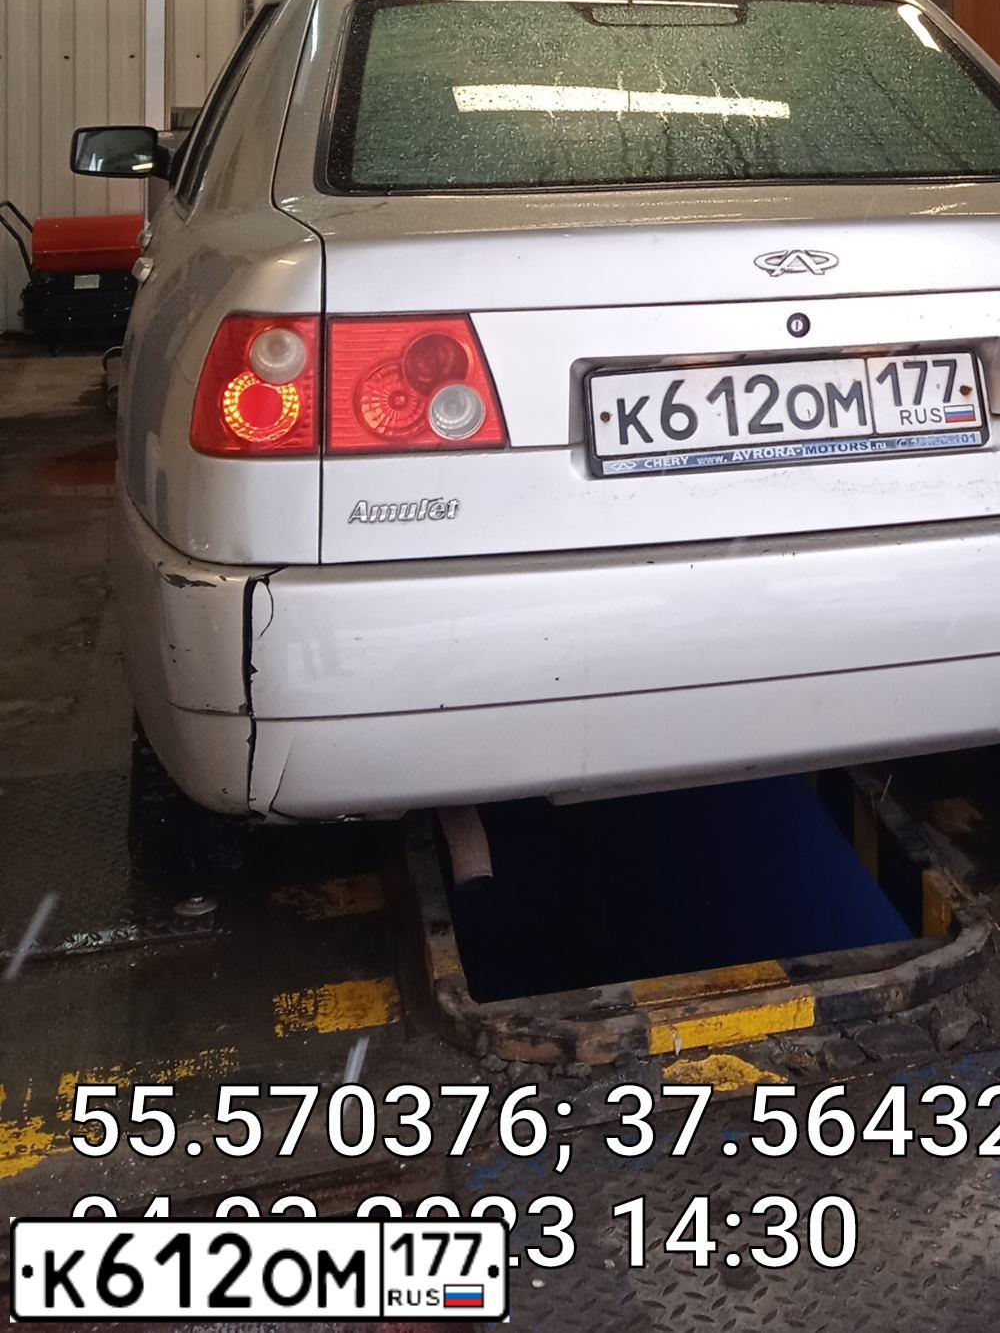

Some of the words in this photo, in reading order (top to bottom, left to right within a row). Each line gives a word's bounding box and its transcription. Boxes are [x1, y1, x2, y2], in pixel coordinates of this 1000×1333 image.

[876, 359, 957, 407] 177
[900, 407, 942, 426] RUS
[643, 456, 689, 468] CHERY
[348, 497, 460, 524] Amulet
